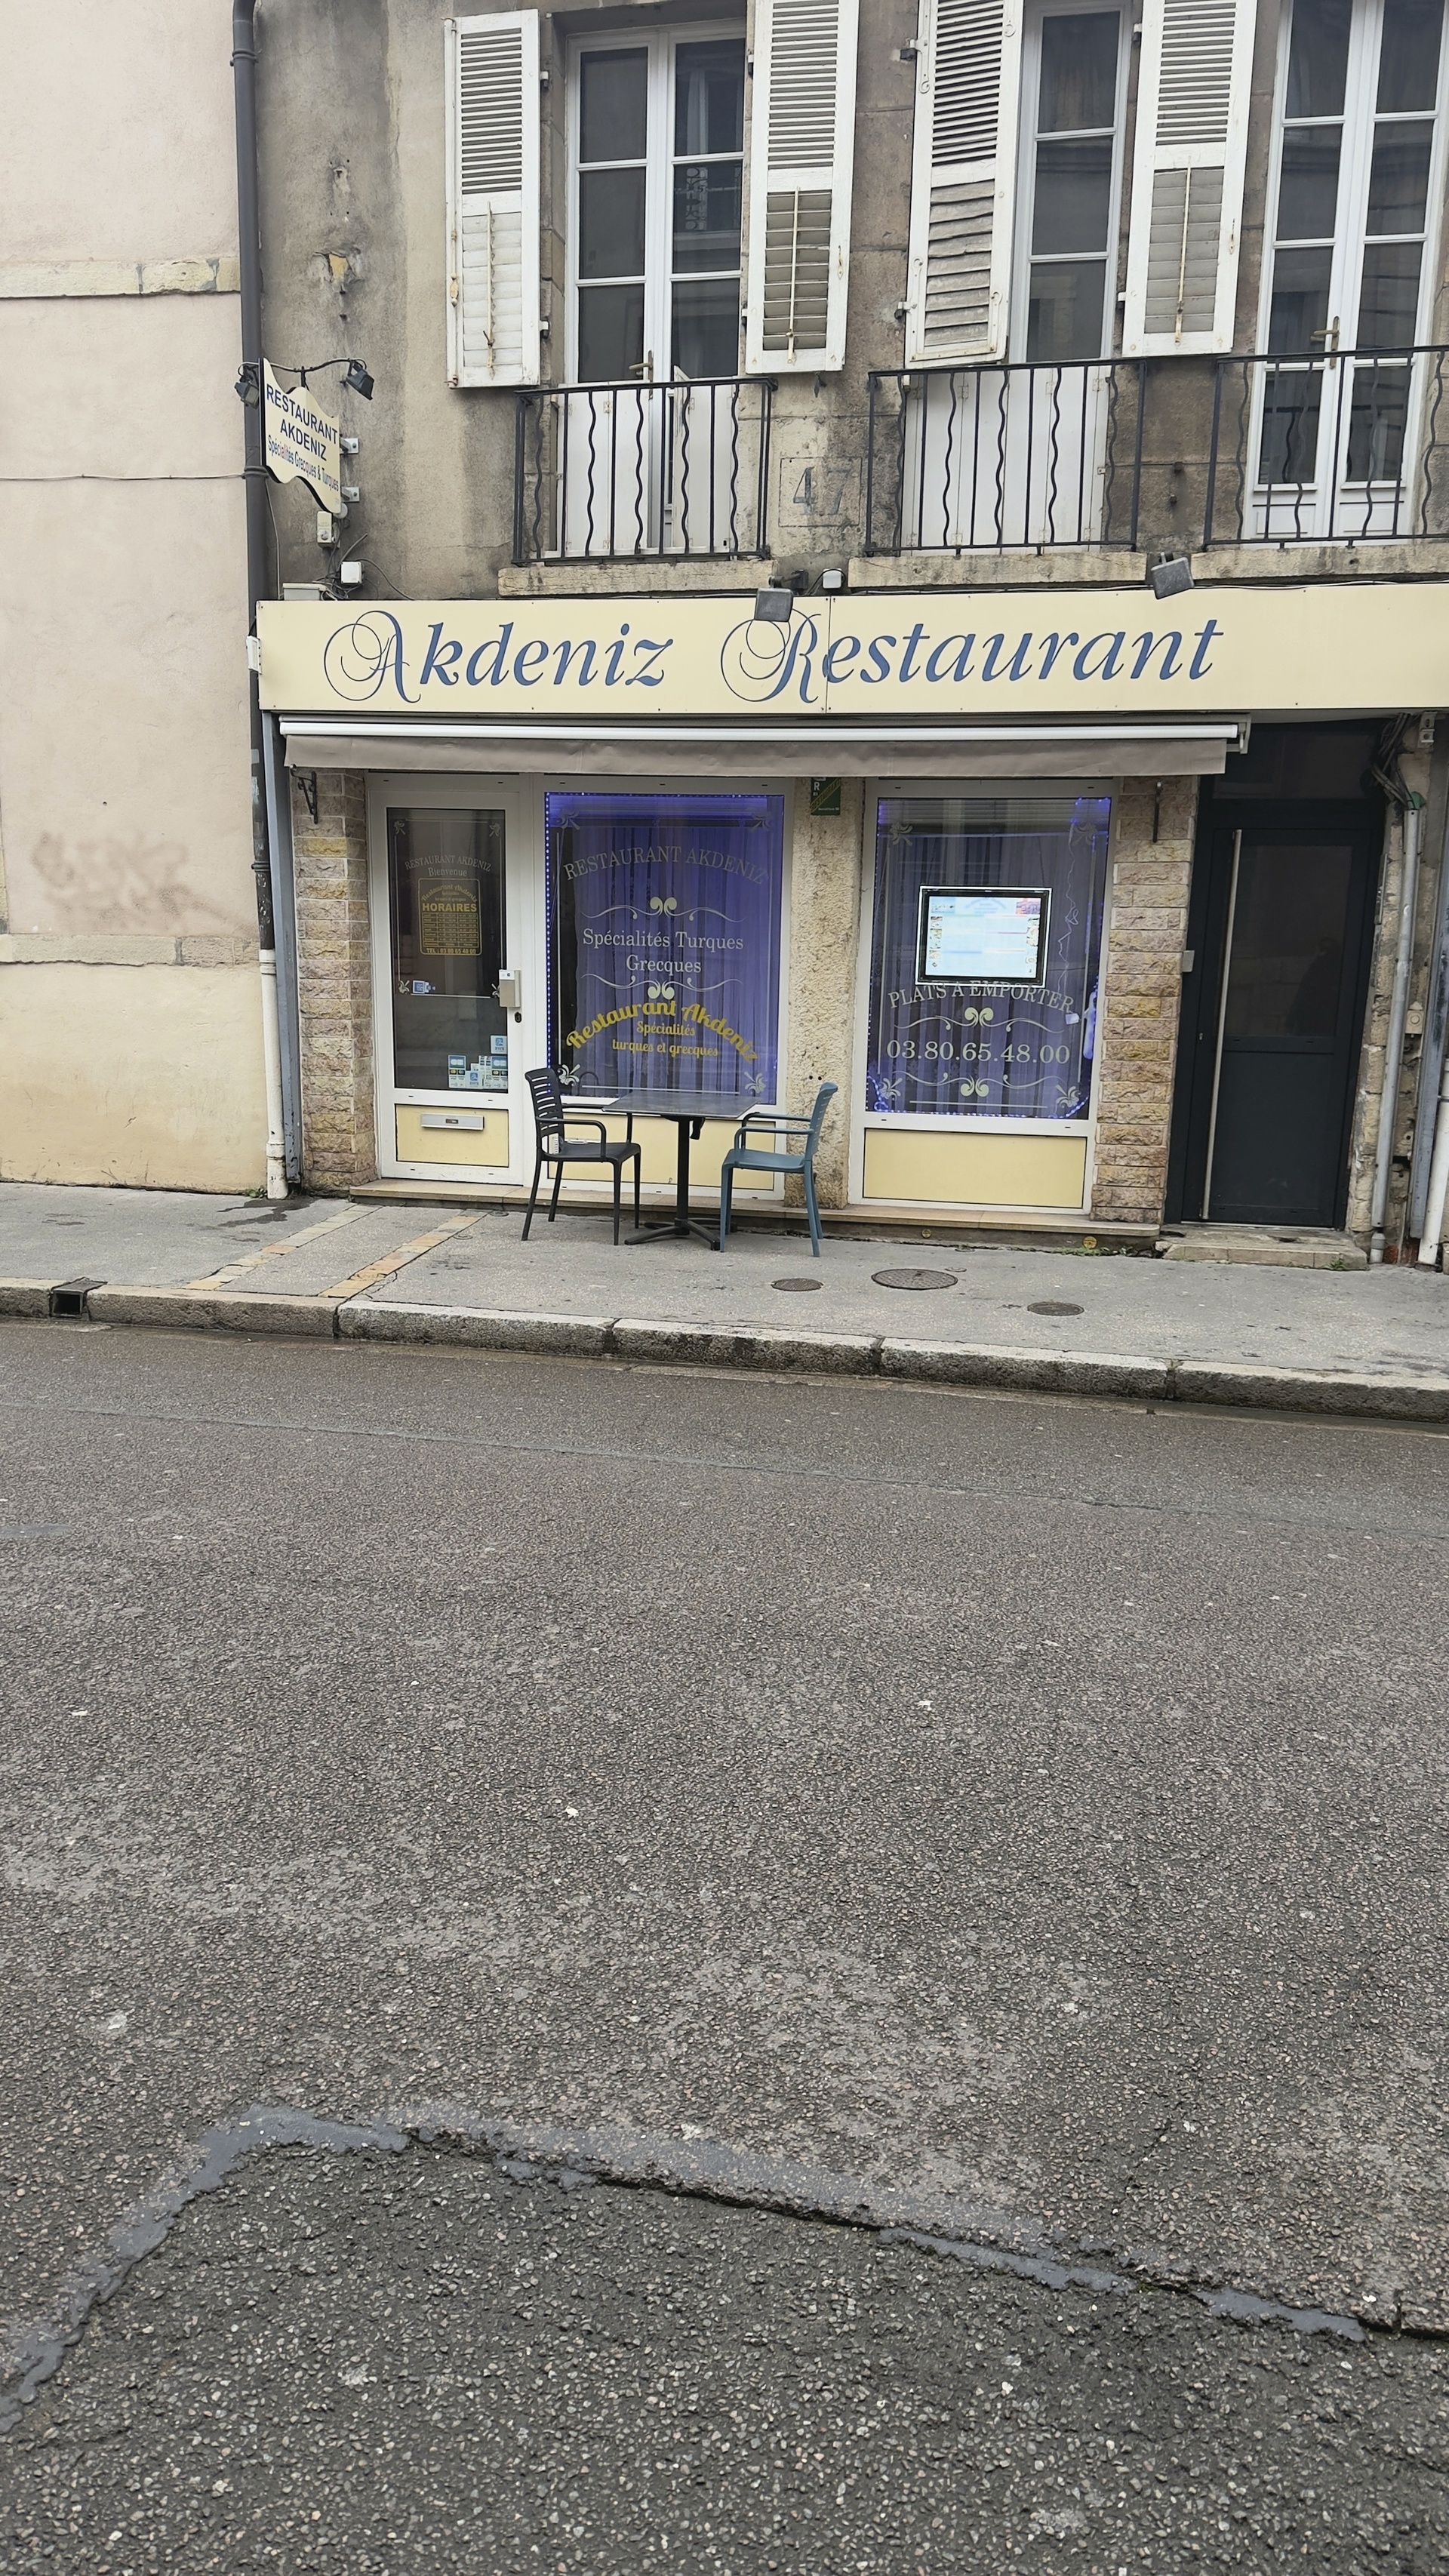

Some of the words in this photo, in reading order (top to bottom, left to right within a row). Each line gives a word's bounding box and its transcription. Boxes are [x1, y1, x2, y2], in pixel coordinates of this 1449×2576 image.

[266, 383, 337, 445] RESTAURANT
[280, 418, 327, 461] AKDENIZ
[268, 435, 294, 465] Spécialités
[294, 451, 317, 479] Grecques
[317, 465, 321, 481] &
[321, 467, 340, 492] Turques
[793, 466, 852, 516] 47
[324, 610, 674, 703] Akdeniz
[721, 608, 1224, 703] Restaurant
[405, 855, 455, 870] RESTAURANT
[457, 855, 491, 872] AKDENIZ
[428, 867, 467, 877] Bienvenue
[563, 846, 681, 881] RESTAURANT
[685, 848, 769, 885] AKDENIZ
[423, 903, 477, 912] HORAIRES
[583, 928, 670, 949] Spécialités
[675, 931, 743, 953] Turques
[626, 955, 702, 976] Grecques
[888, 980, 947, 1009] PLATS
[951, 980, 964, 997] A
[969, 980, 1075, 1012] EMPORTER
[565, 1000, 677, 1050] Restaurant
[681, 1002, 759, 1063] Akdeniz
[636, 1020, 695, 1037] Spécialités
[611, 1039, 654, 1054] turques
[657, 1042, 666, 1054] et
[669, 1045, 718, 1059] grecques
[886, 1039, 1071, 1064] 03.80.65.48.00
